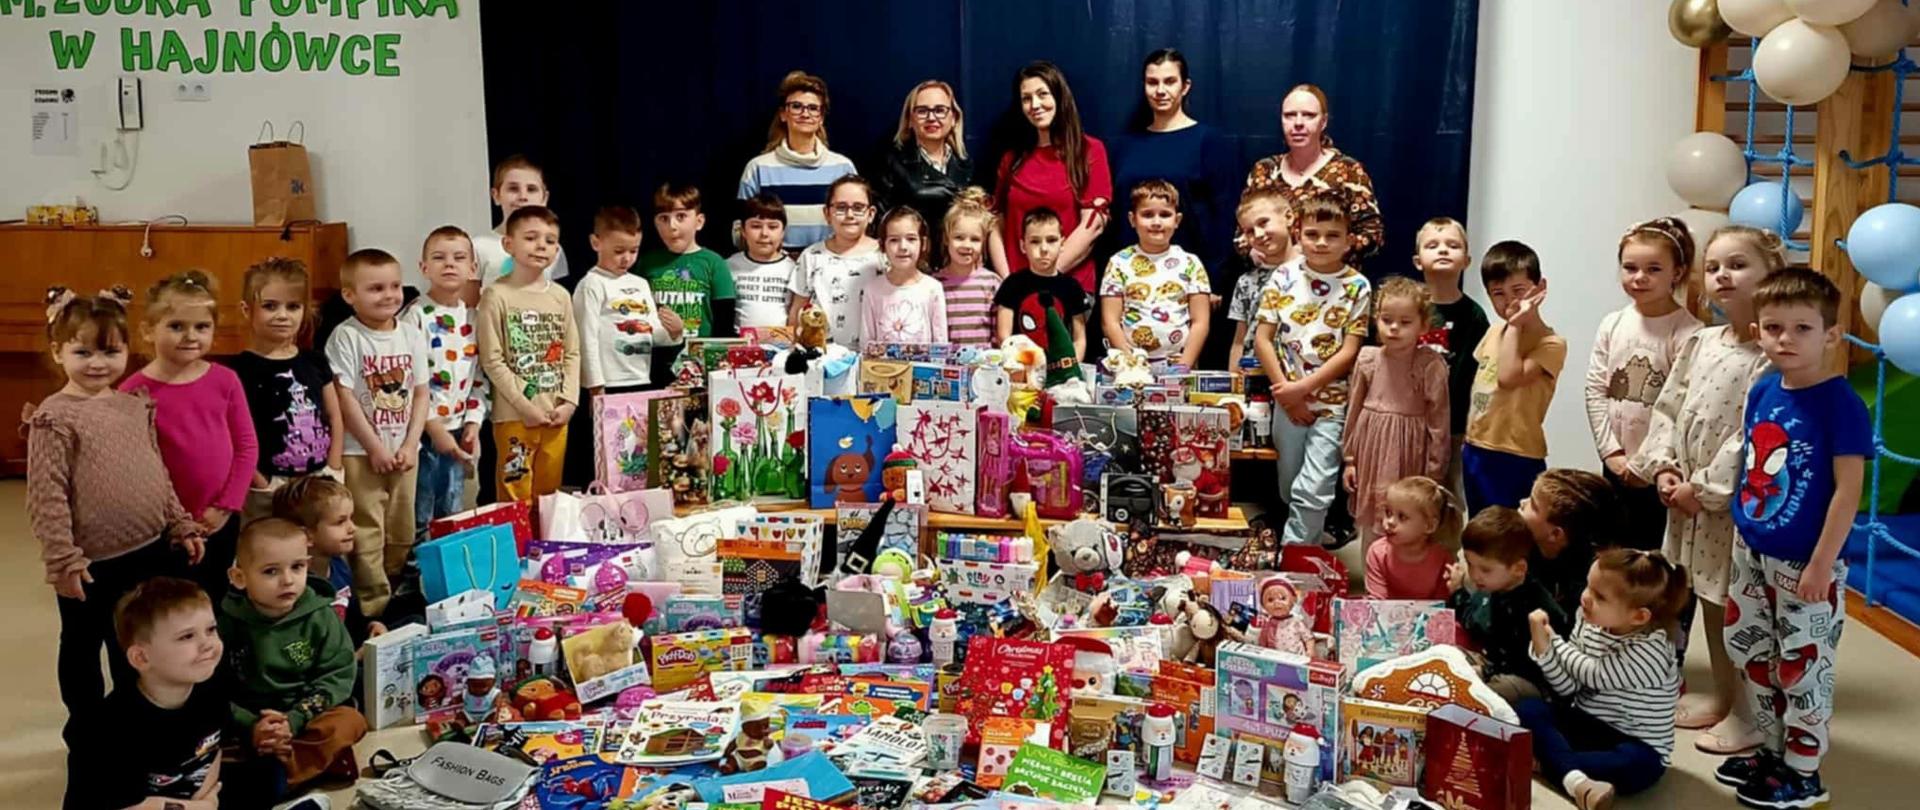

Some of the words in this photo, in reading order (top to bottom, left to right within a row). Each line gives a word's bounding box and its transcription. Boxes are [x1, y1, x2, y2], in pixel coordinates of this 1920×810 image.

[49, 30, 96, 70] W
[120, 21, 402, 77] HAJNÓWCE
[430, 757, 473, 777] FASHION
[476, 769, 506, 787] BAGS
